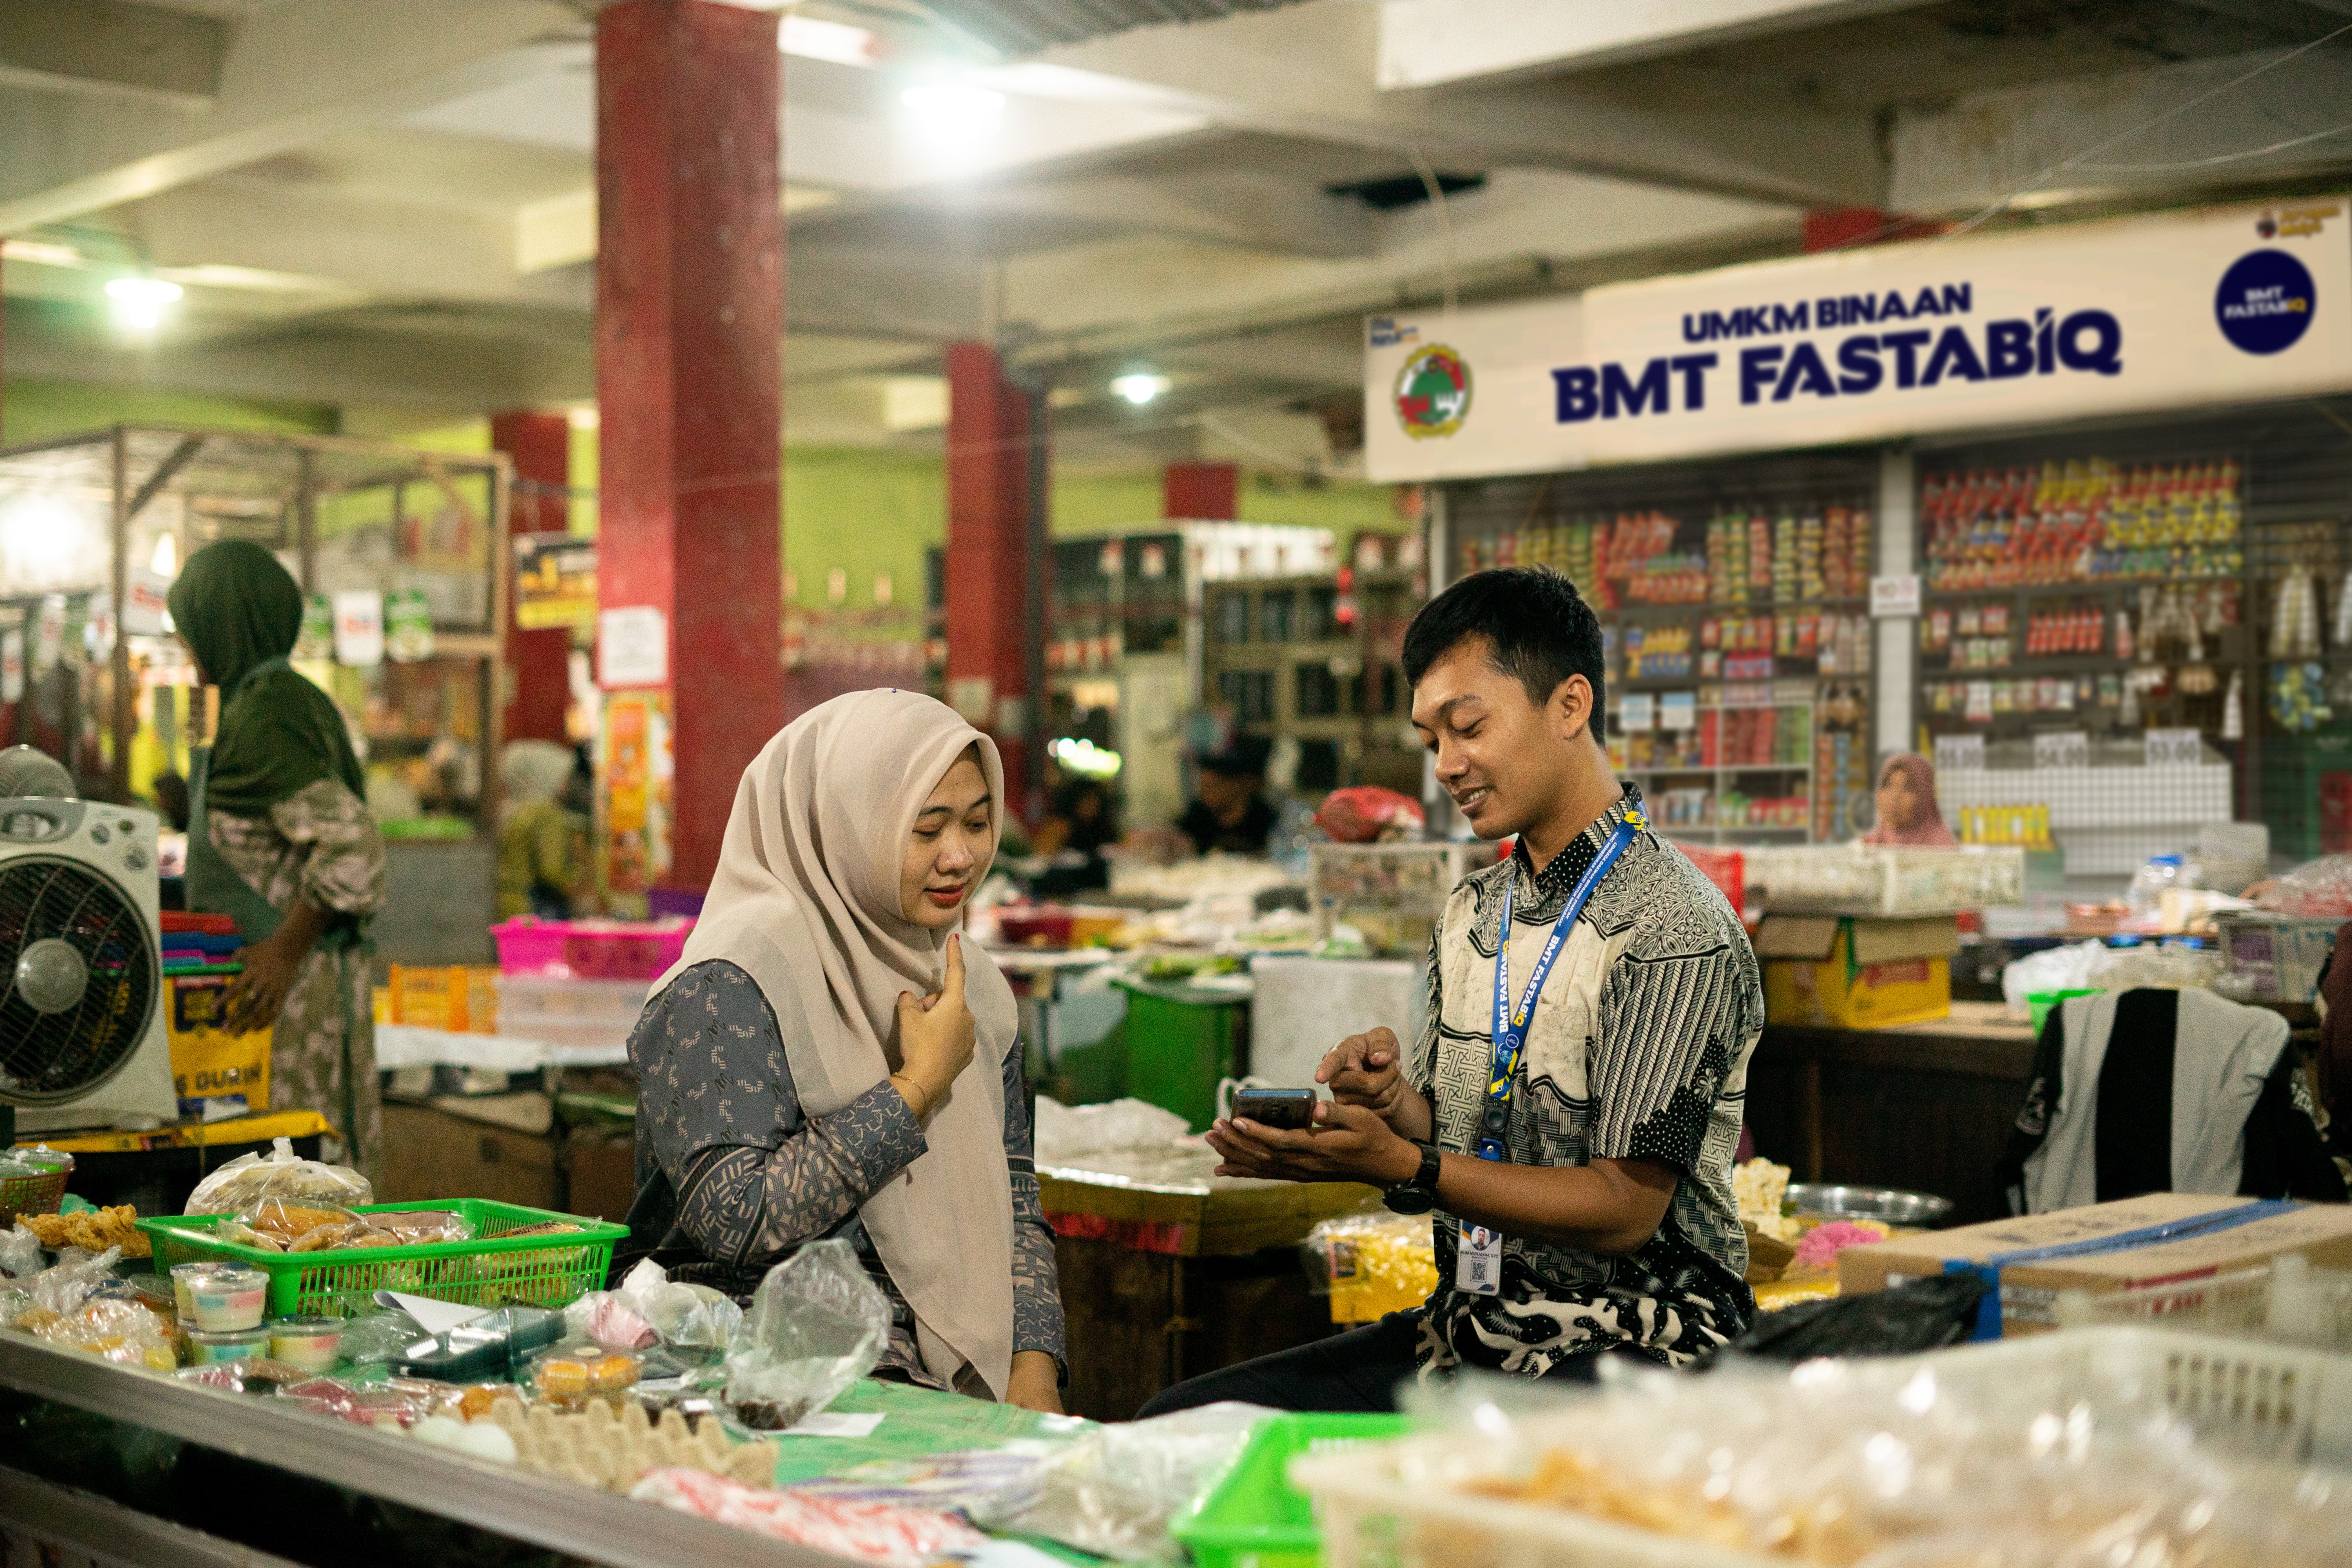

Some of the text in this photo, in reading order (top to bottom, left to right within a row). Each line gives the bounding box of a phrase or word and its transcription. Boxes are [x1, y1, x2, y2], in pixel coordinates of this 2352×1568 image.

[2245, 286, 2283, 302] BMT
[1682, 282, 1971, 344] UMKM BINAAN
[1551, 352, 1719, 424] BMT
[1602, 842, 1617, 862] LEMBAGA
[1558, 832, 1619, 927] YANG MEMBERIKAN SOLUSI UNTUK MASYARAKAT
[1589, 861, 1604, 880] DAKWAH
[1576, 879, 1591, 900] BERBASIS
[1542, 935, 1560, 966] BMT
[1499, 1004, 1509, 1034] BMT
